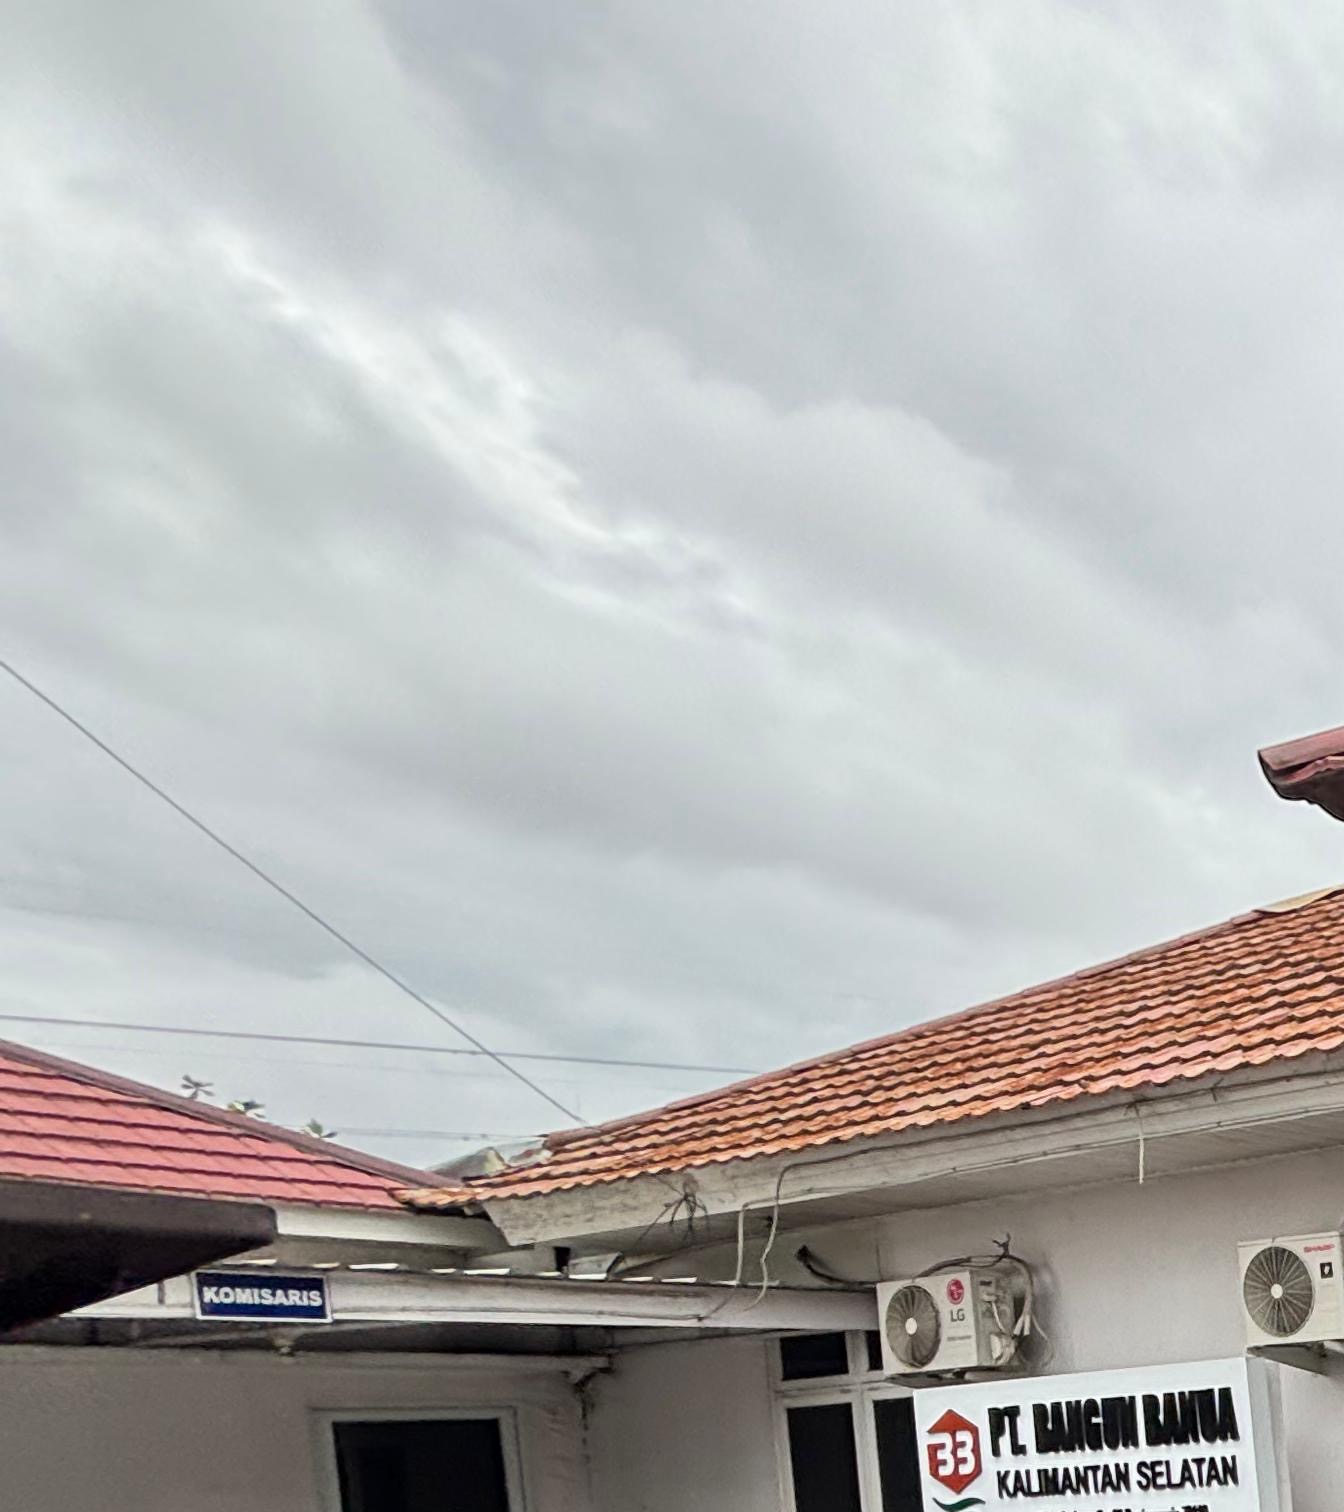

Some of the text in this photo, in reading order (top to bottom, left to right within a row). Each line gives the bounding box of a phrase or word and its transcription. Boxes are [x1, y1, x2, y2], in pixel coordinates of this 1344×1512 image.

[203, 1286, 322, 1307] KOMISARIS
[950, 1308, 966, 1322] LG
[1032, 1395, 1139, 1454] BANGUN
[1142, 1387, 1240, 1447] BANUA
[997, 1455, 1239, 1499] KALIMANTAN SELATAN
